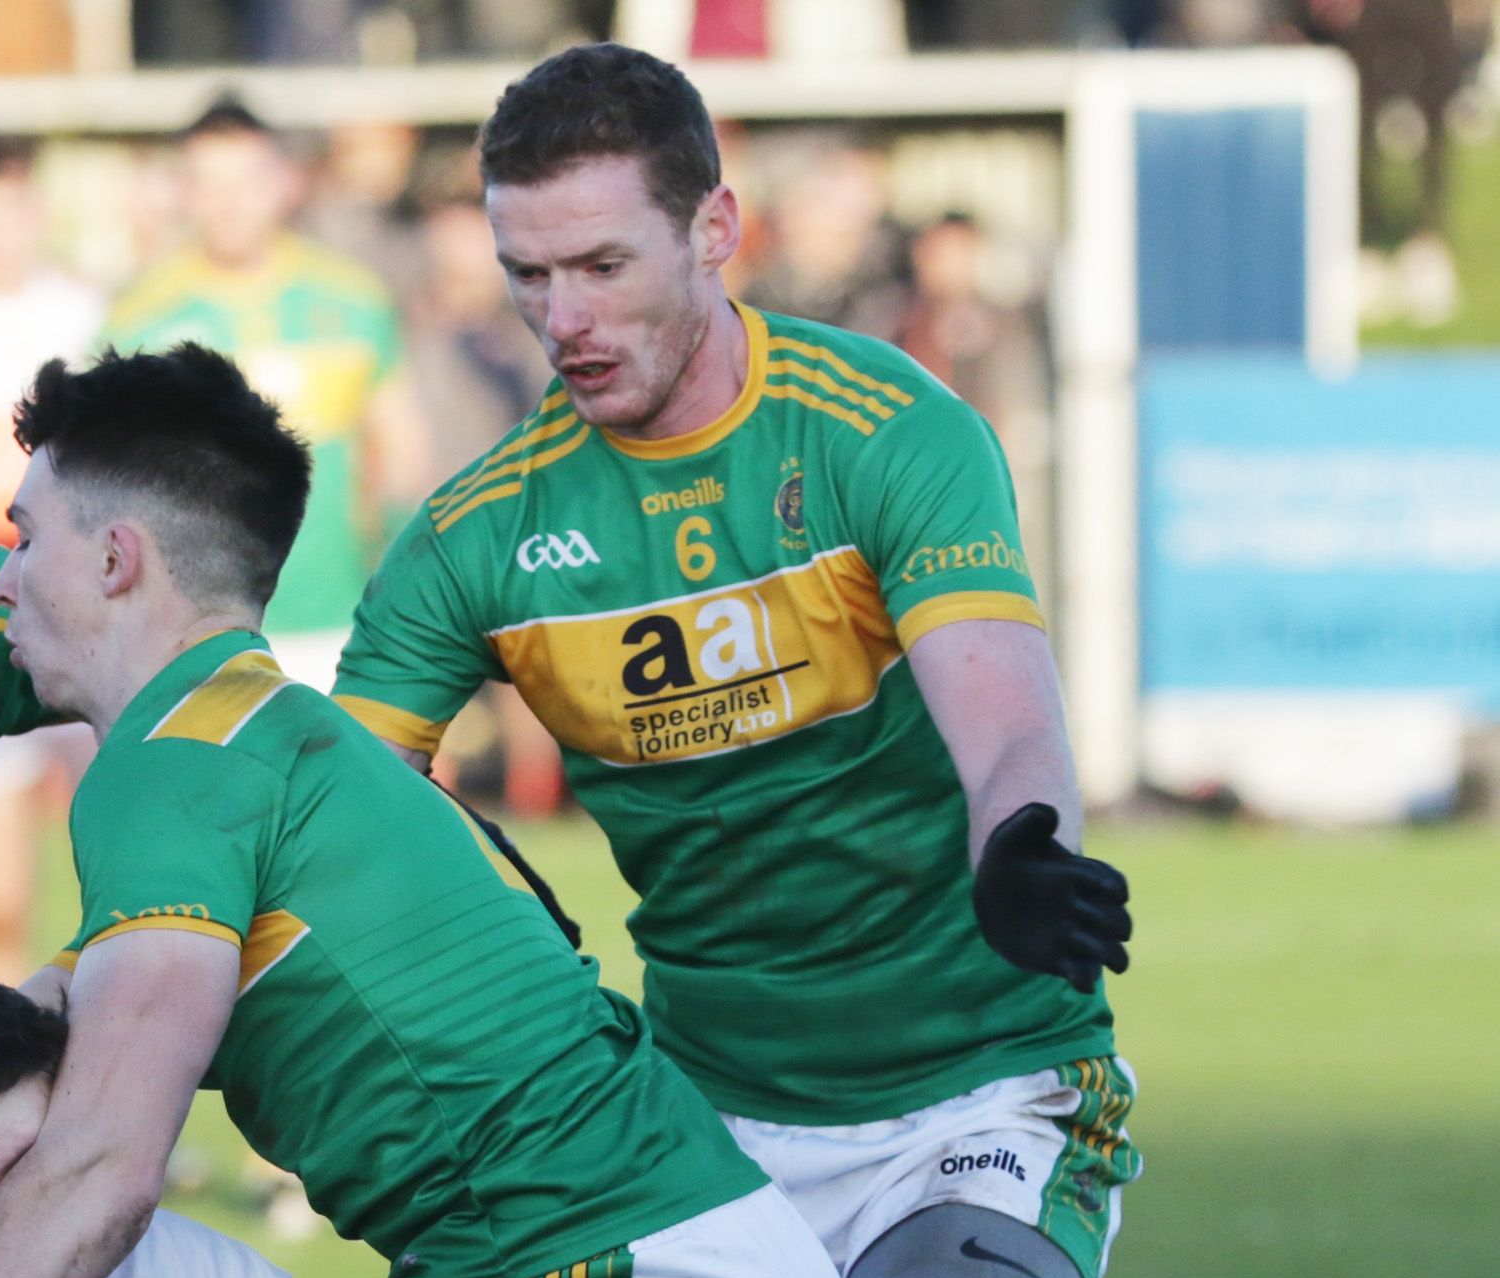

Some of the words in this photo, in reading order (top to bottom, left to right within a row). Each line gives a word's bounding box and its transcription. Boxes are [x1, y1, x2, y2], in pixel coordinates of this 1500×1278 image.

[675, 515, 717, 582] 6
[630, 684, 772, 736] specialist
[636, 718, 735, 762] joinery
[735, 710, 778, 735] LTD
